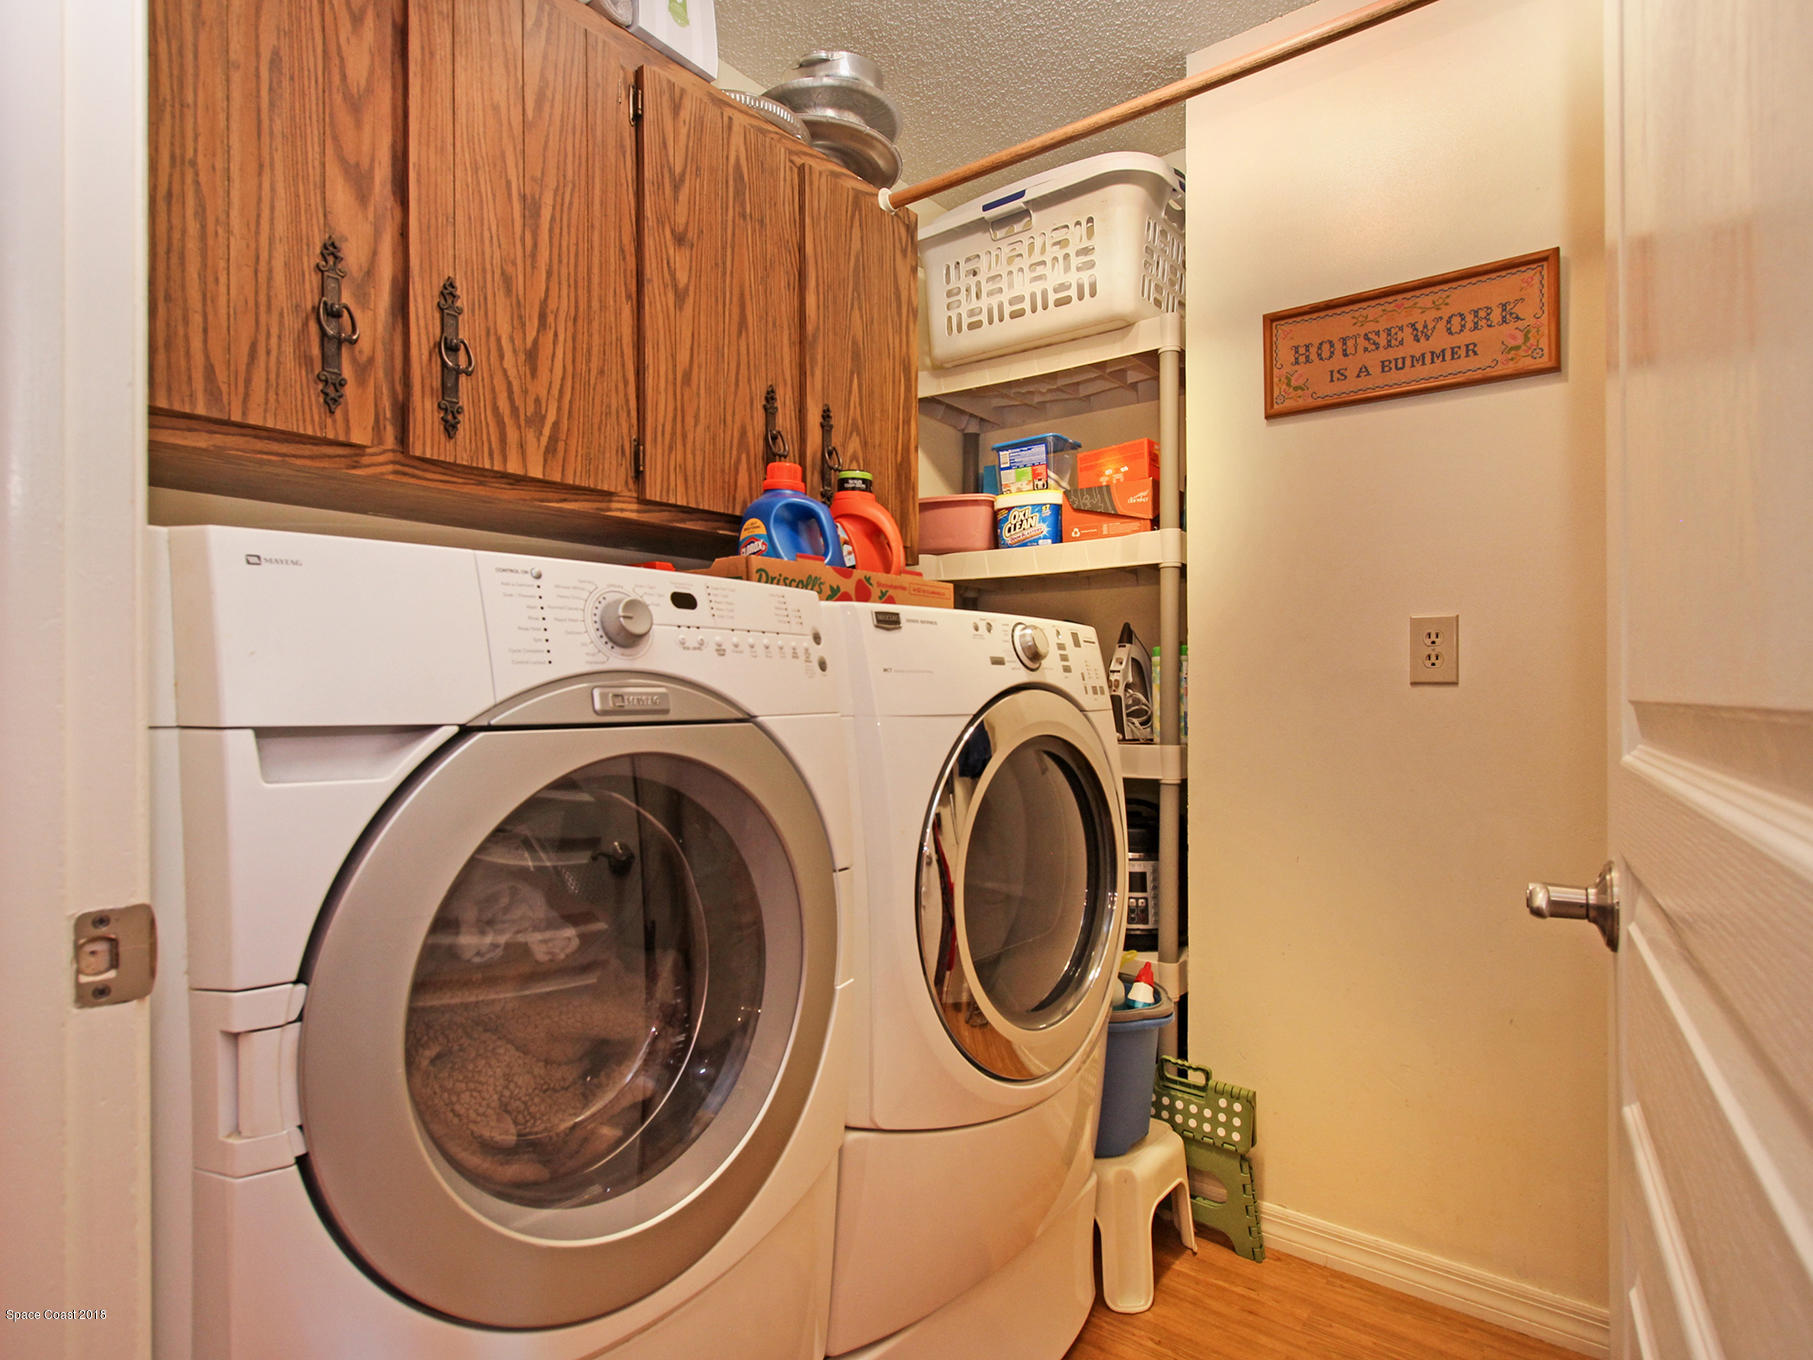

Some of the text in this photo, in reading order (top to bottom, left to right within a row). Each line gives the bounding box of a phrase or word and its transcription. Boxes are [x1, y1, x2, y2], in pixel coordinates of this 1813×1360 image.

[1290, 297, 1527, 366] HOUSEWORK
[1328, 342, 1479, 383] IS A BUMMER
[1004, 514, 1038, 538] CLEAN
[1009, 507, 1031, 523] OXI
[755, 567, 825, 595] Driscoll's
